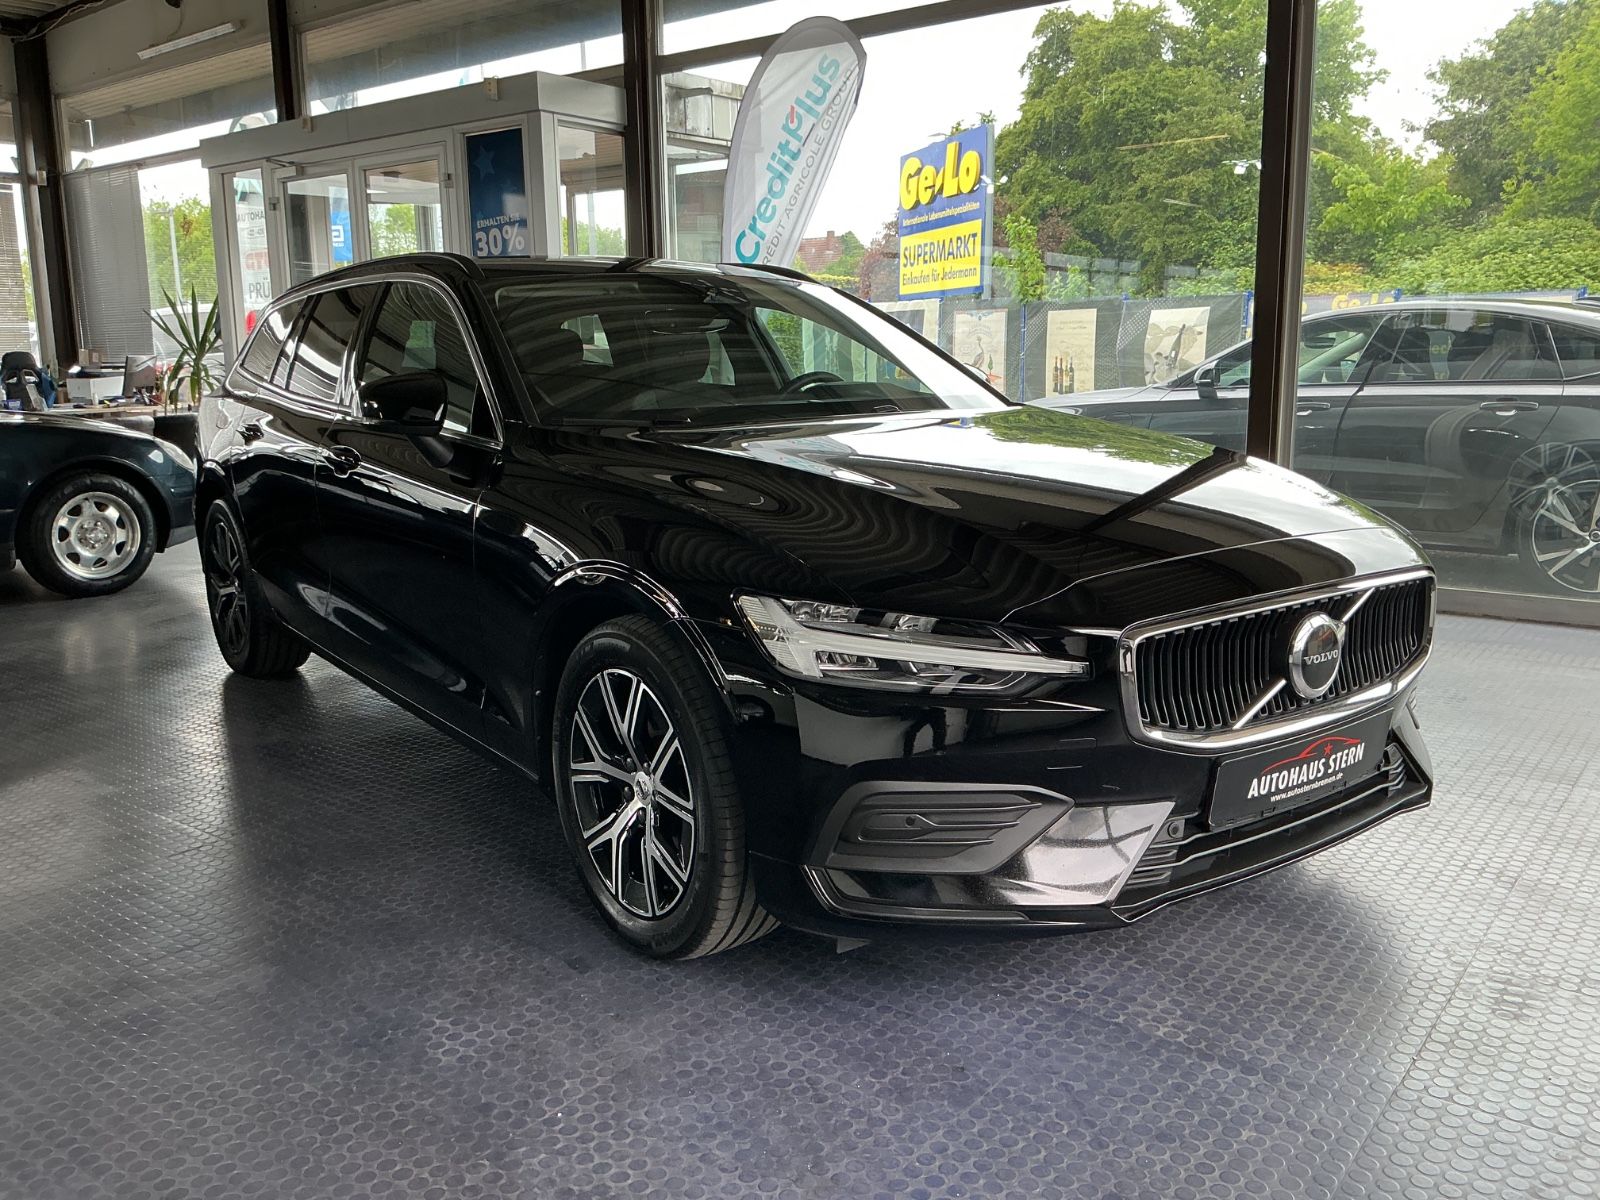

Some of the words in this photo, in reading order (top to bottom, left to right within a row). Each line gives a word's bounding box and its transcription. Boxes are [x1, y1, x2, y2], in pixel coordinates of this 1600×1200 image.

[785, 133, 825, 220] AGRICOLE
[475, 223, 525, 257] 30%
[903, 232, 977, 268] SUPERMARKT
[902, 270, 930, 286] Einkaufen
[931, 267, 941, 282] für
[940, 265, 977, 281] Jedermann
[1304, 650, 1338, 665] VOLVO
[1247, 757, 1325, 799] AUTOHAUS
[1328, 742, 1365, 774] STERN
[1270, 772, 1344, 803] www.autosternbremen.de
